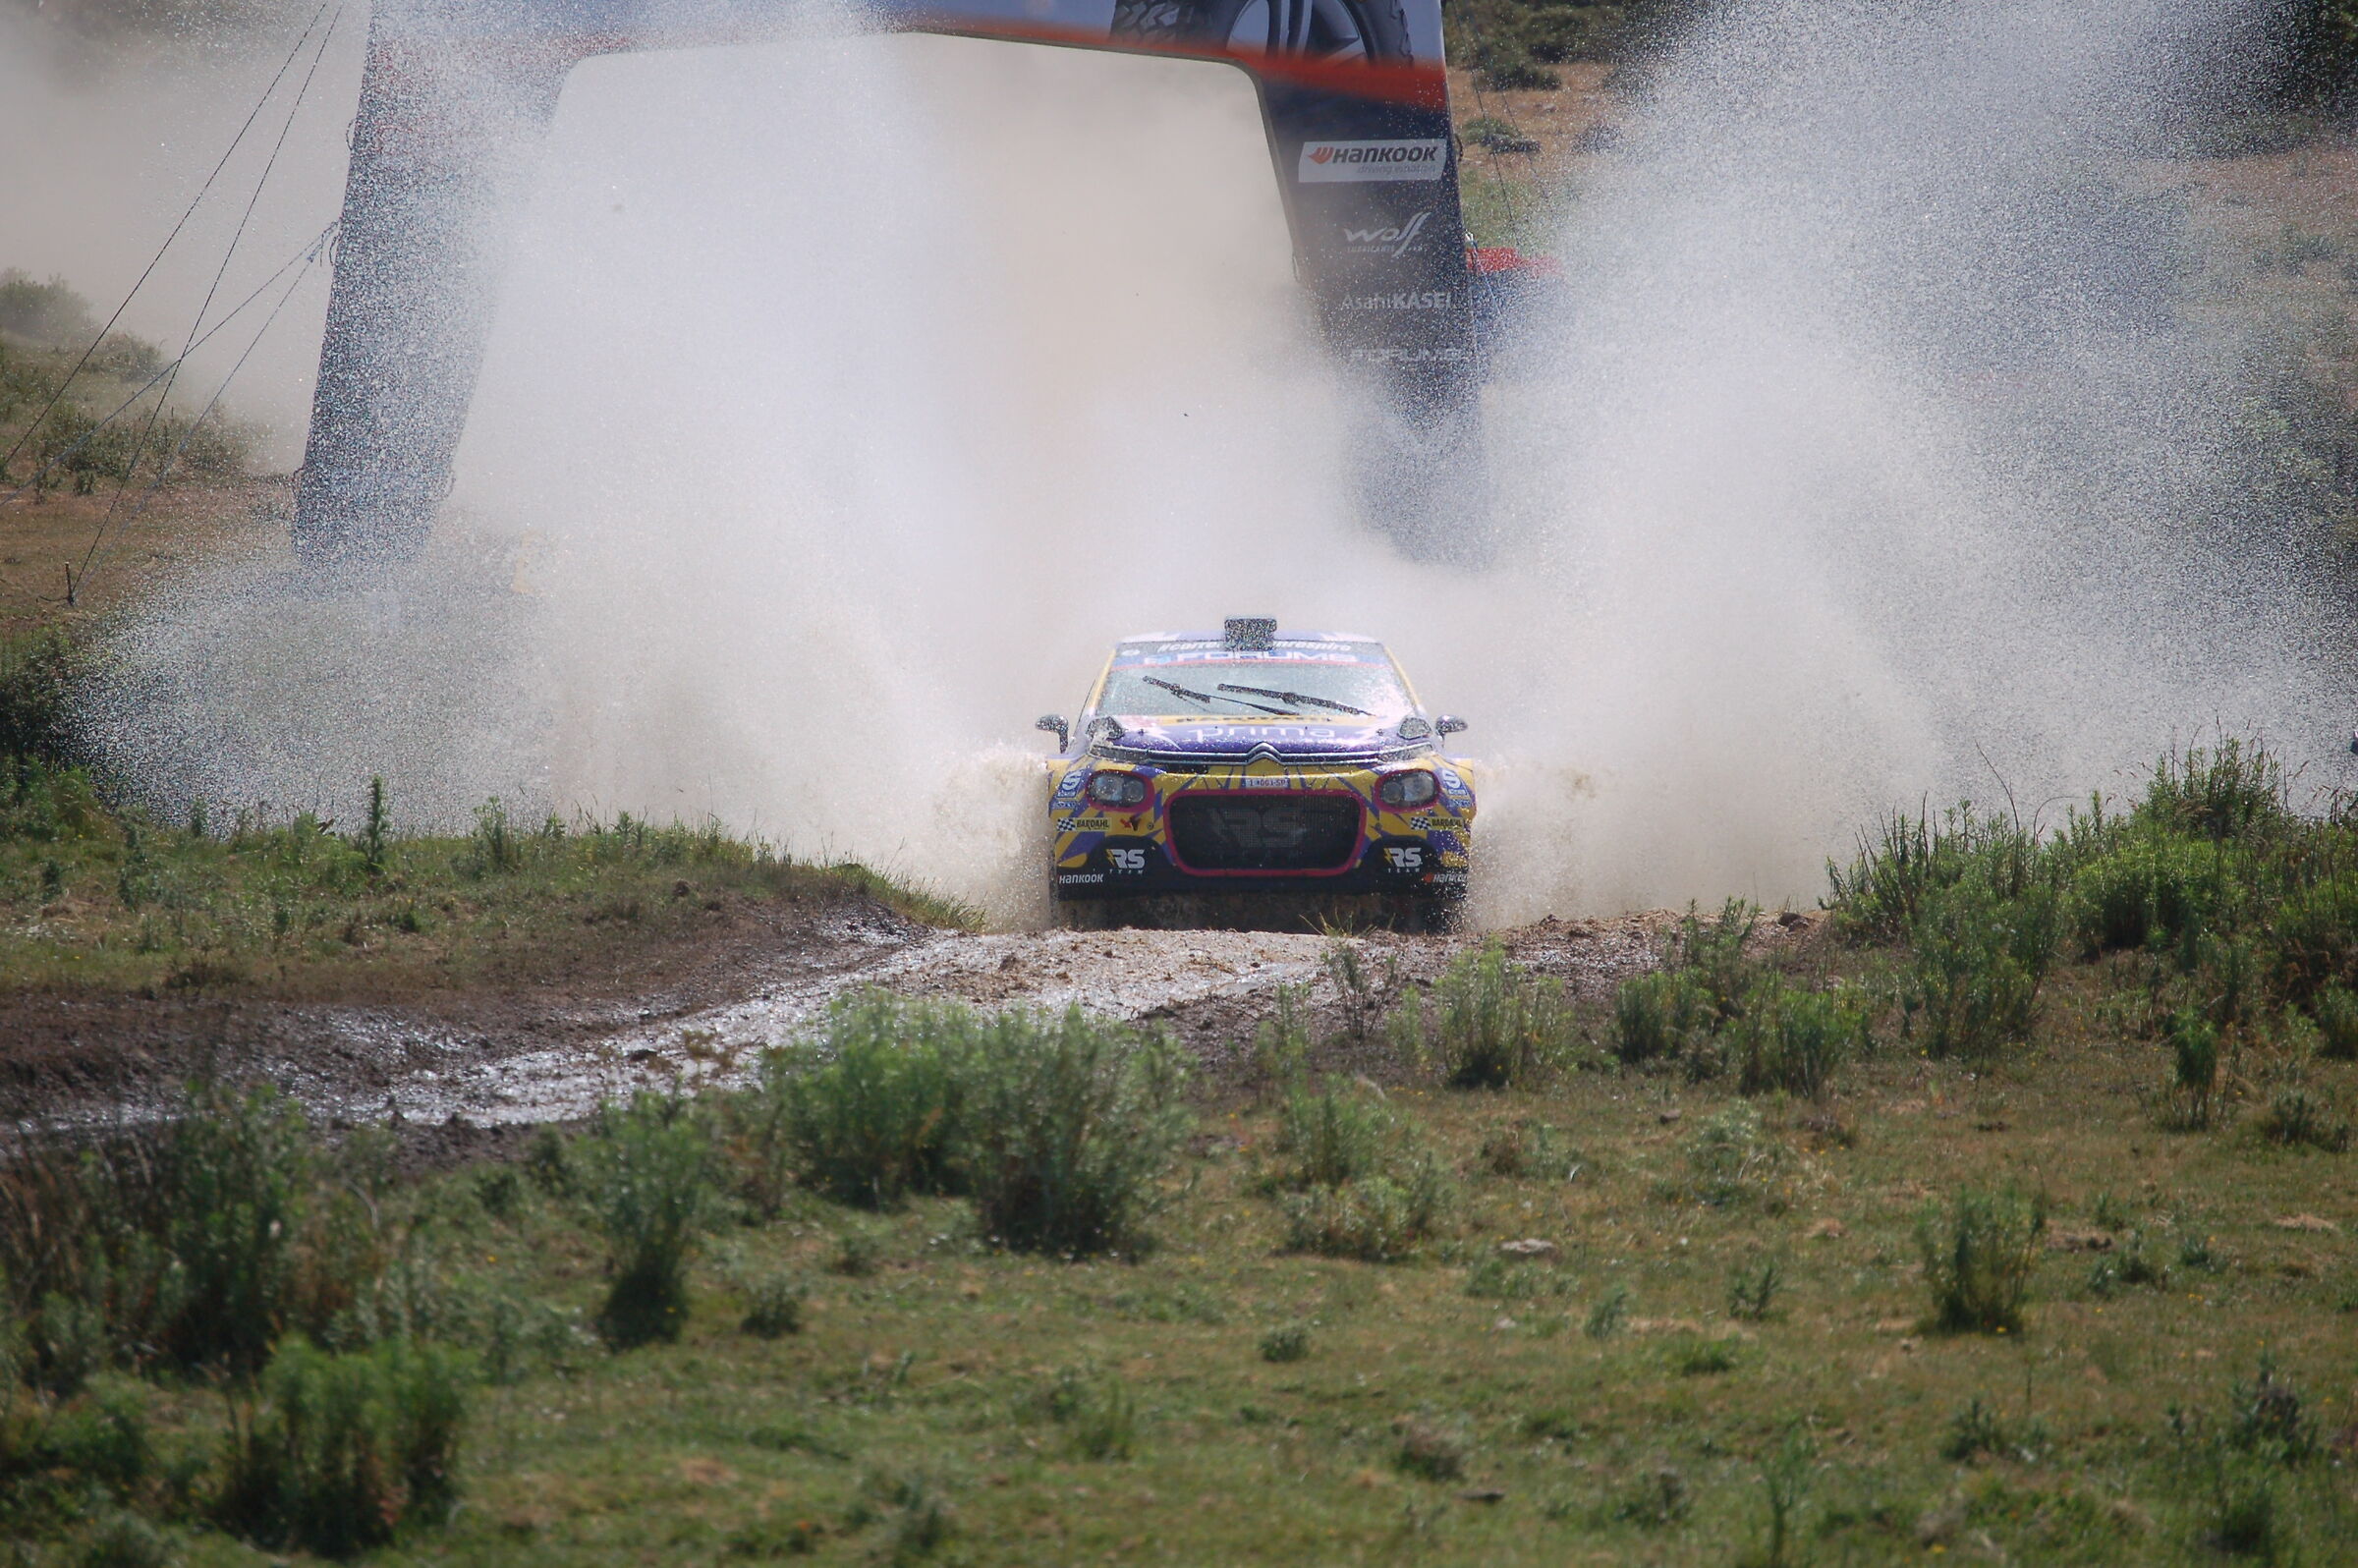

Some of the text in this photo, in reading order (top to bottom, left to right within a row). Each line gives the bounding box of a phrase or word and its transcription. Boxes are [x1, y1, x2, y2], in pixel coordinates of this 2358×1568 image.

[1188, 725, 1336, 744] prima
[1112, 849, 1146, 868] RS
[1389, 847, 1422, 868] RS
